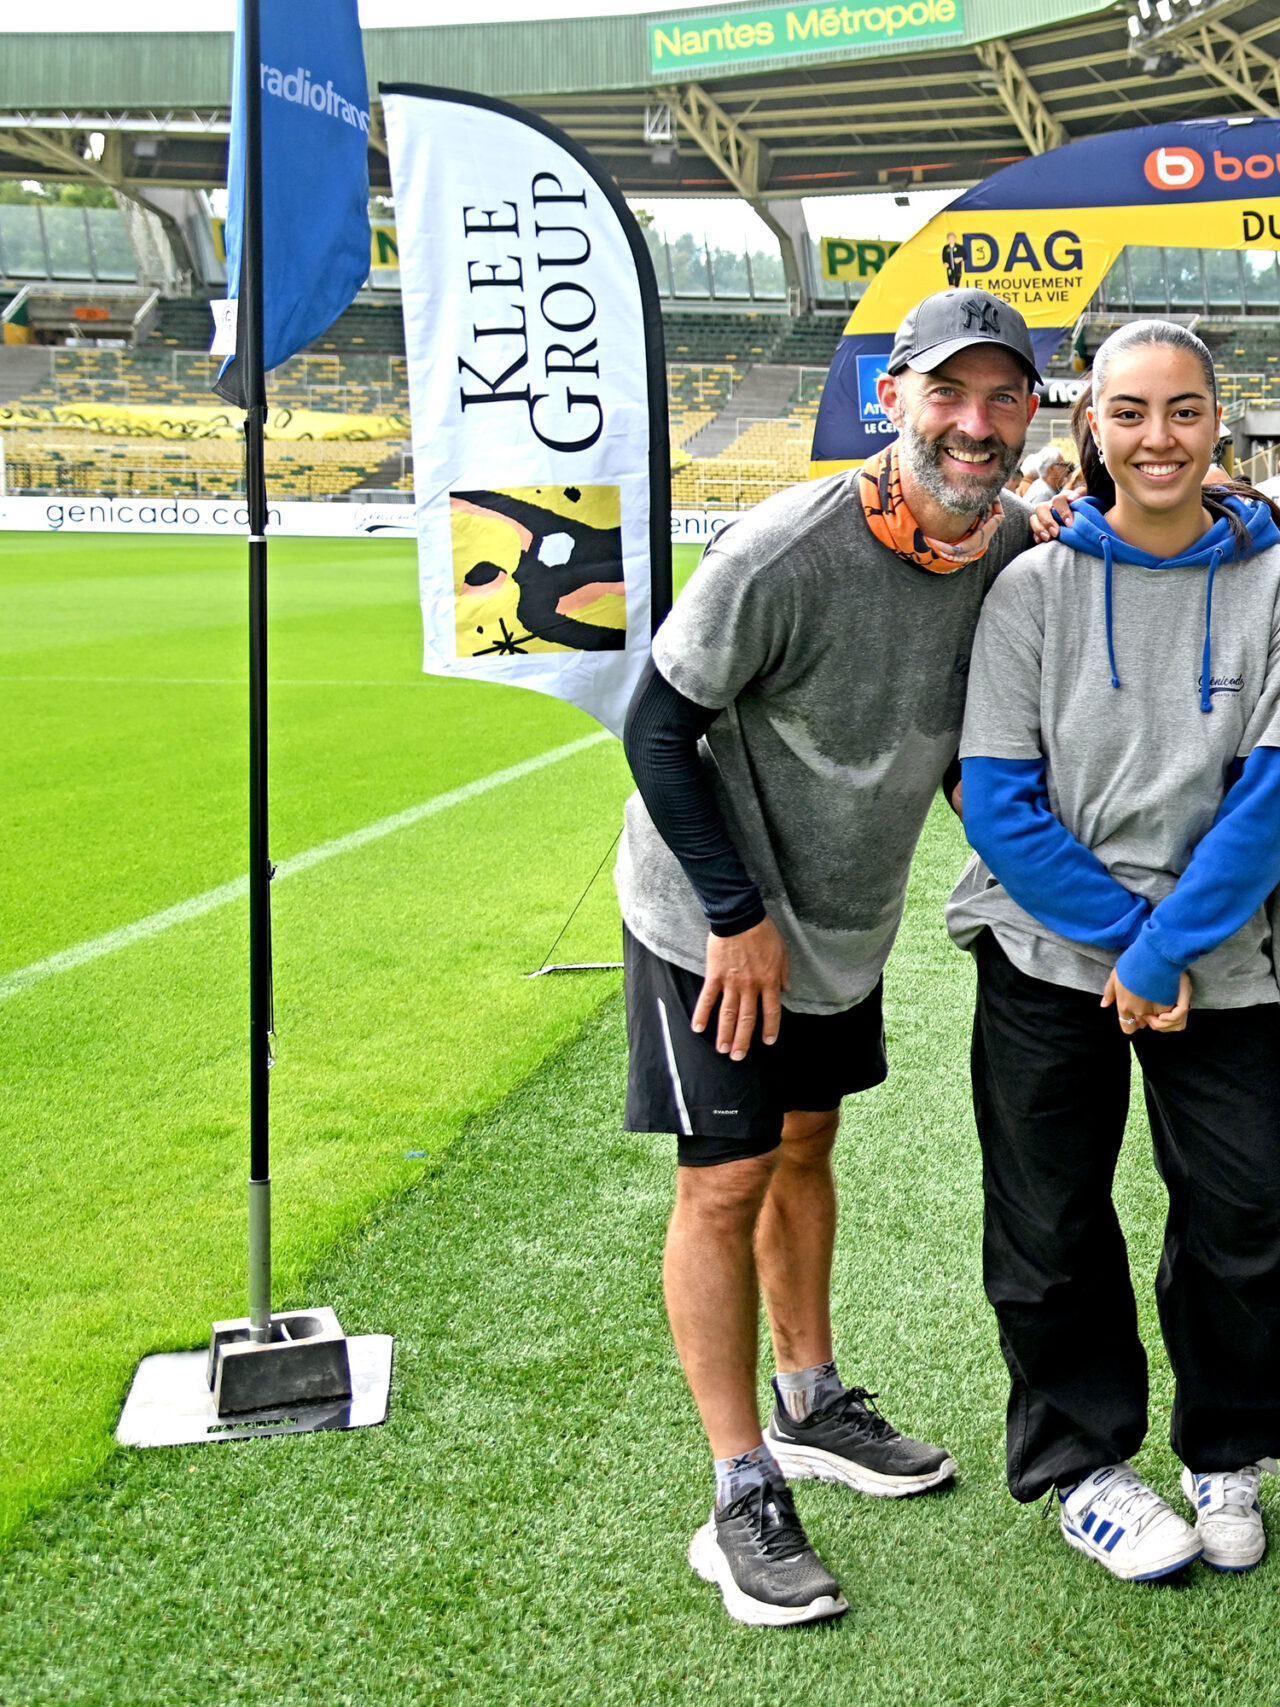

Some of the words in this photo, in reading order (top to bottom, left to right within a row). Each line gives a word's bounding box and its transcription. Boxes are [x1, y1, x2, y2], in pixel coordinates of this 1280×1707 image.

[653, 21, 775, 58] Nantes
[260, 62, 370, 135] radiofranc
[827, 241, 902, 277] PR
[962, 229, 1084, 273] DAG
[966, 279, 983, 290] LE
[988, 276, 1084, 290] MOUVEMENT
[1024, 291, 1043, 303] LA
[1046, 290, 1070, 303] VIE
[457, 200, 532, 414] KLEE
[529, 171, 604, 453] GROUP
[865, 422, 877, 435] LE
